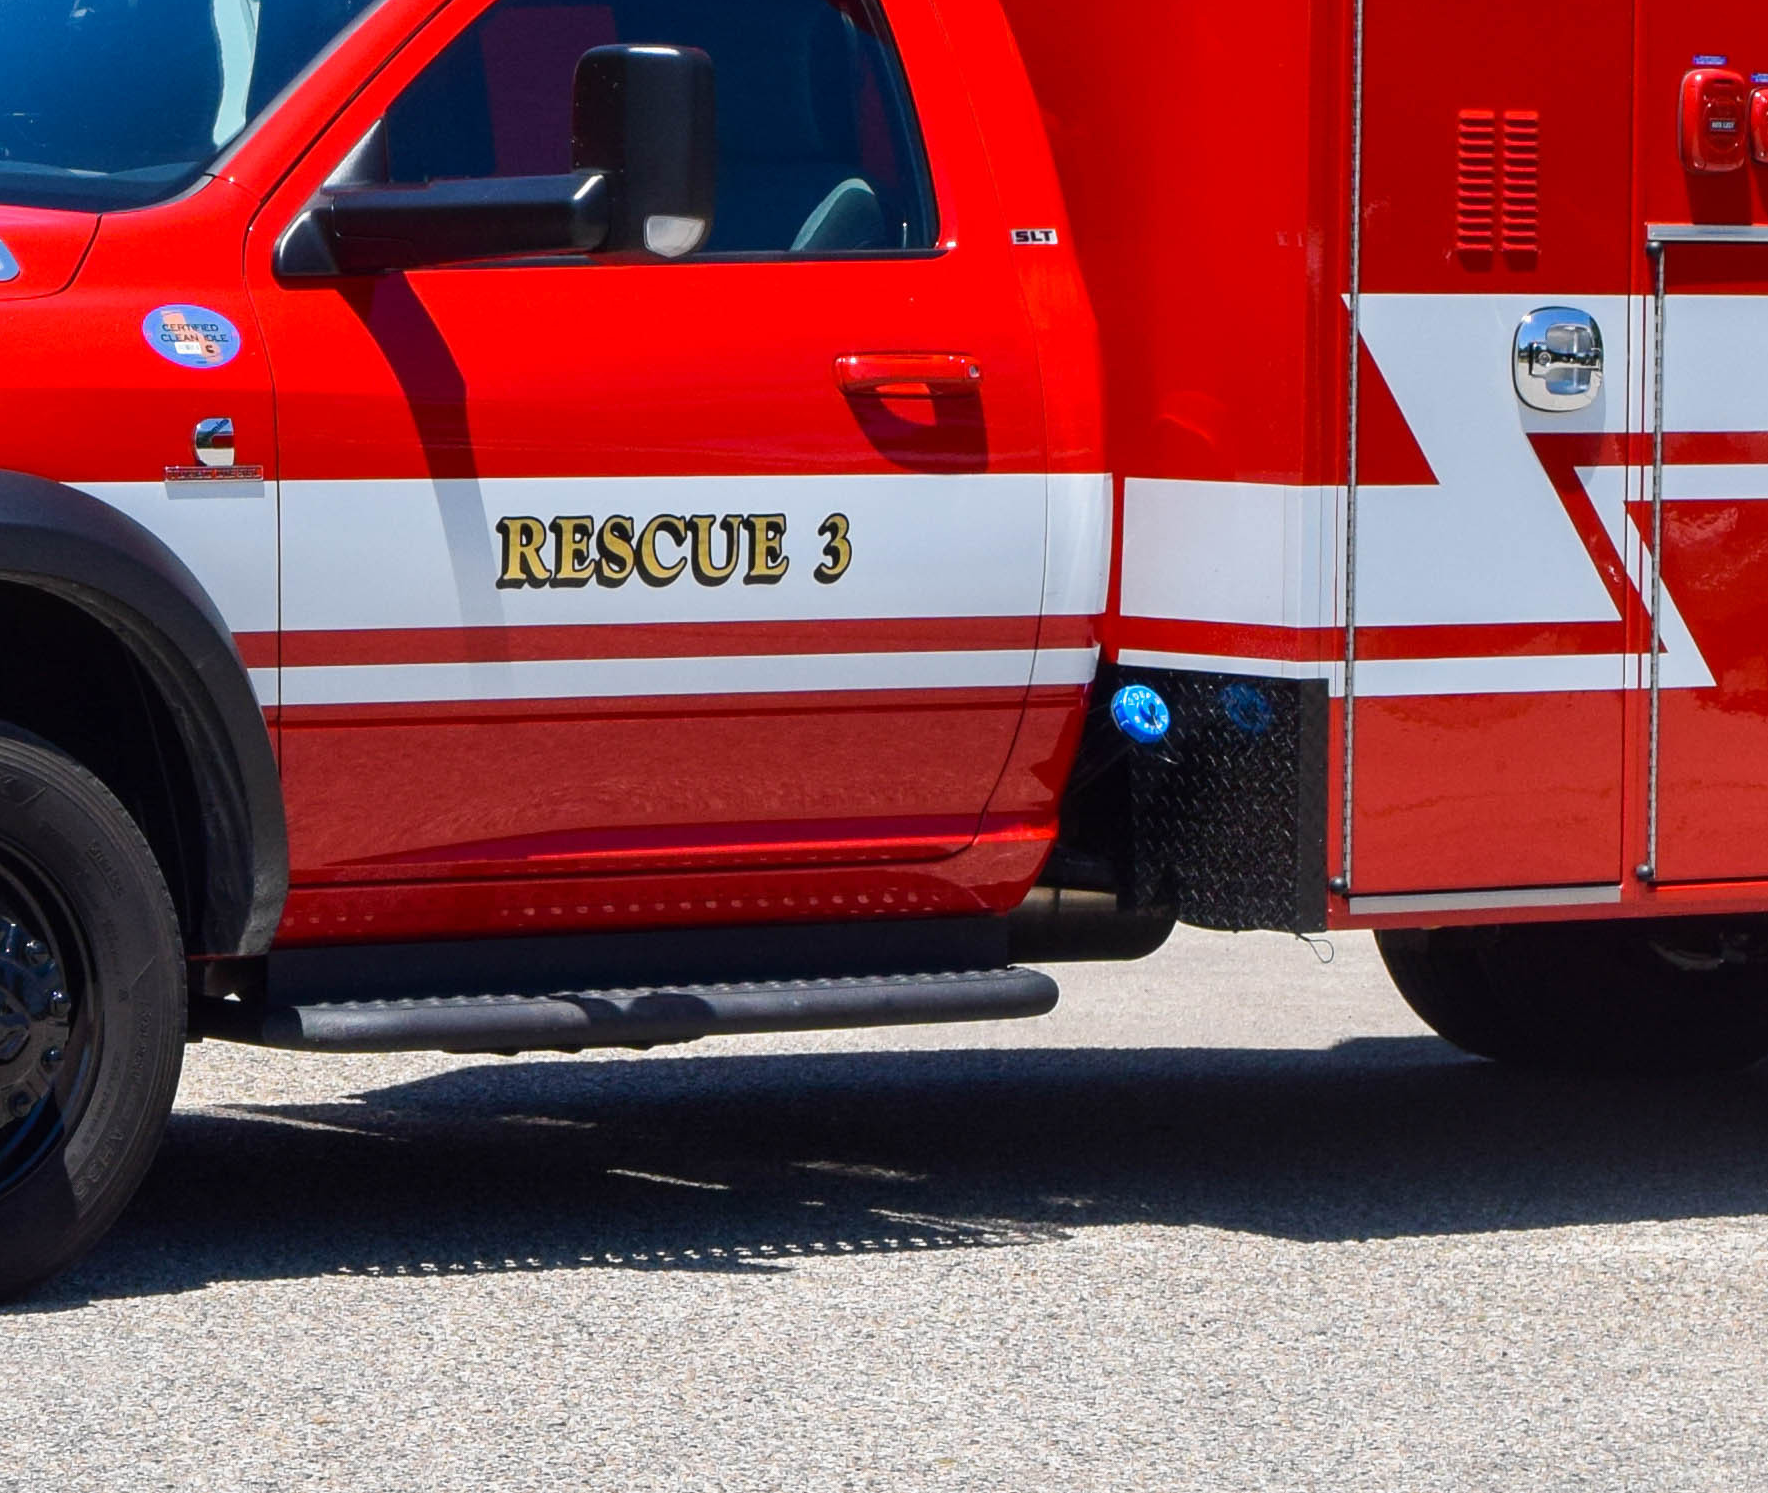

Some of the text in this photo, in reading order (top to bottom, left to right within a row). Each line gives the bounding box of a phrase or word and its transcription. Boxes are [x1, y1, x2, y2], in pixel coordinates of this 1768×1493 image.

[1015, 231, 1053, 243] SLT
[162, 323, 219, 332] CERTIFIED
[161, 333, 199, 342] CLEAN
[496, 512, 853, 589] RESCUE 3
